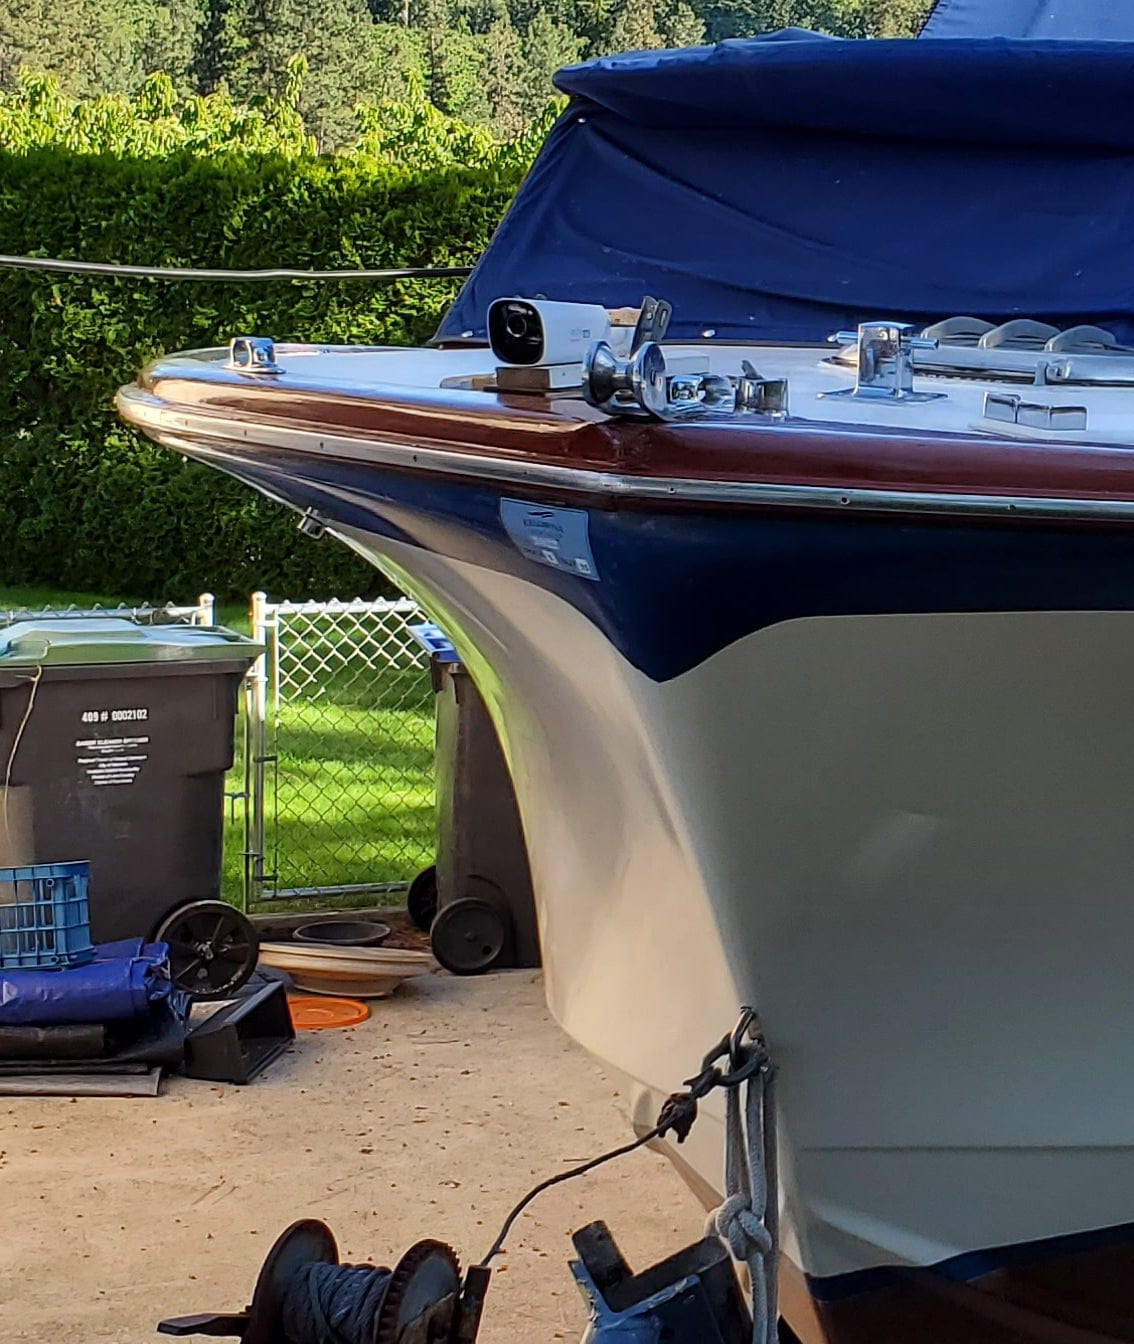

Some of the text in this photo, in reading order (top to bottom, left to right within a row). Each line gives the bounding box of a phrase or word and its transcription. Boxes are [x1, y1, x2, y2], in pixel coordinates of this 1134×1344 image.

[81, 709, 148, 722] 409 # 0002102
